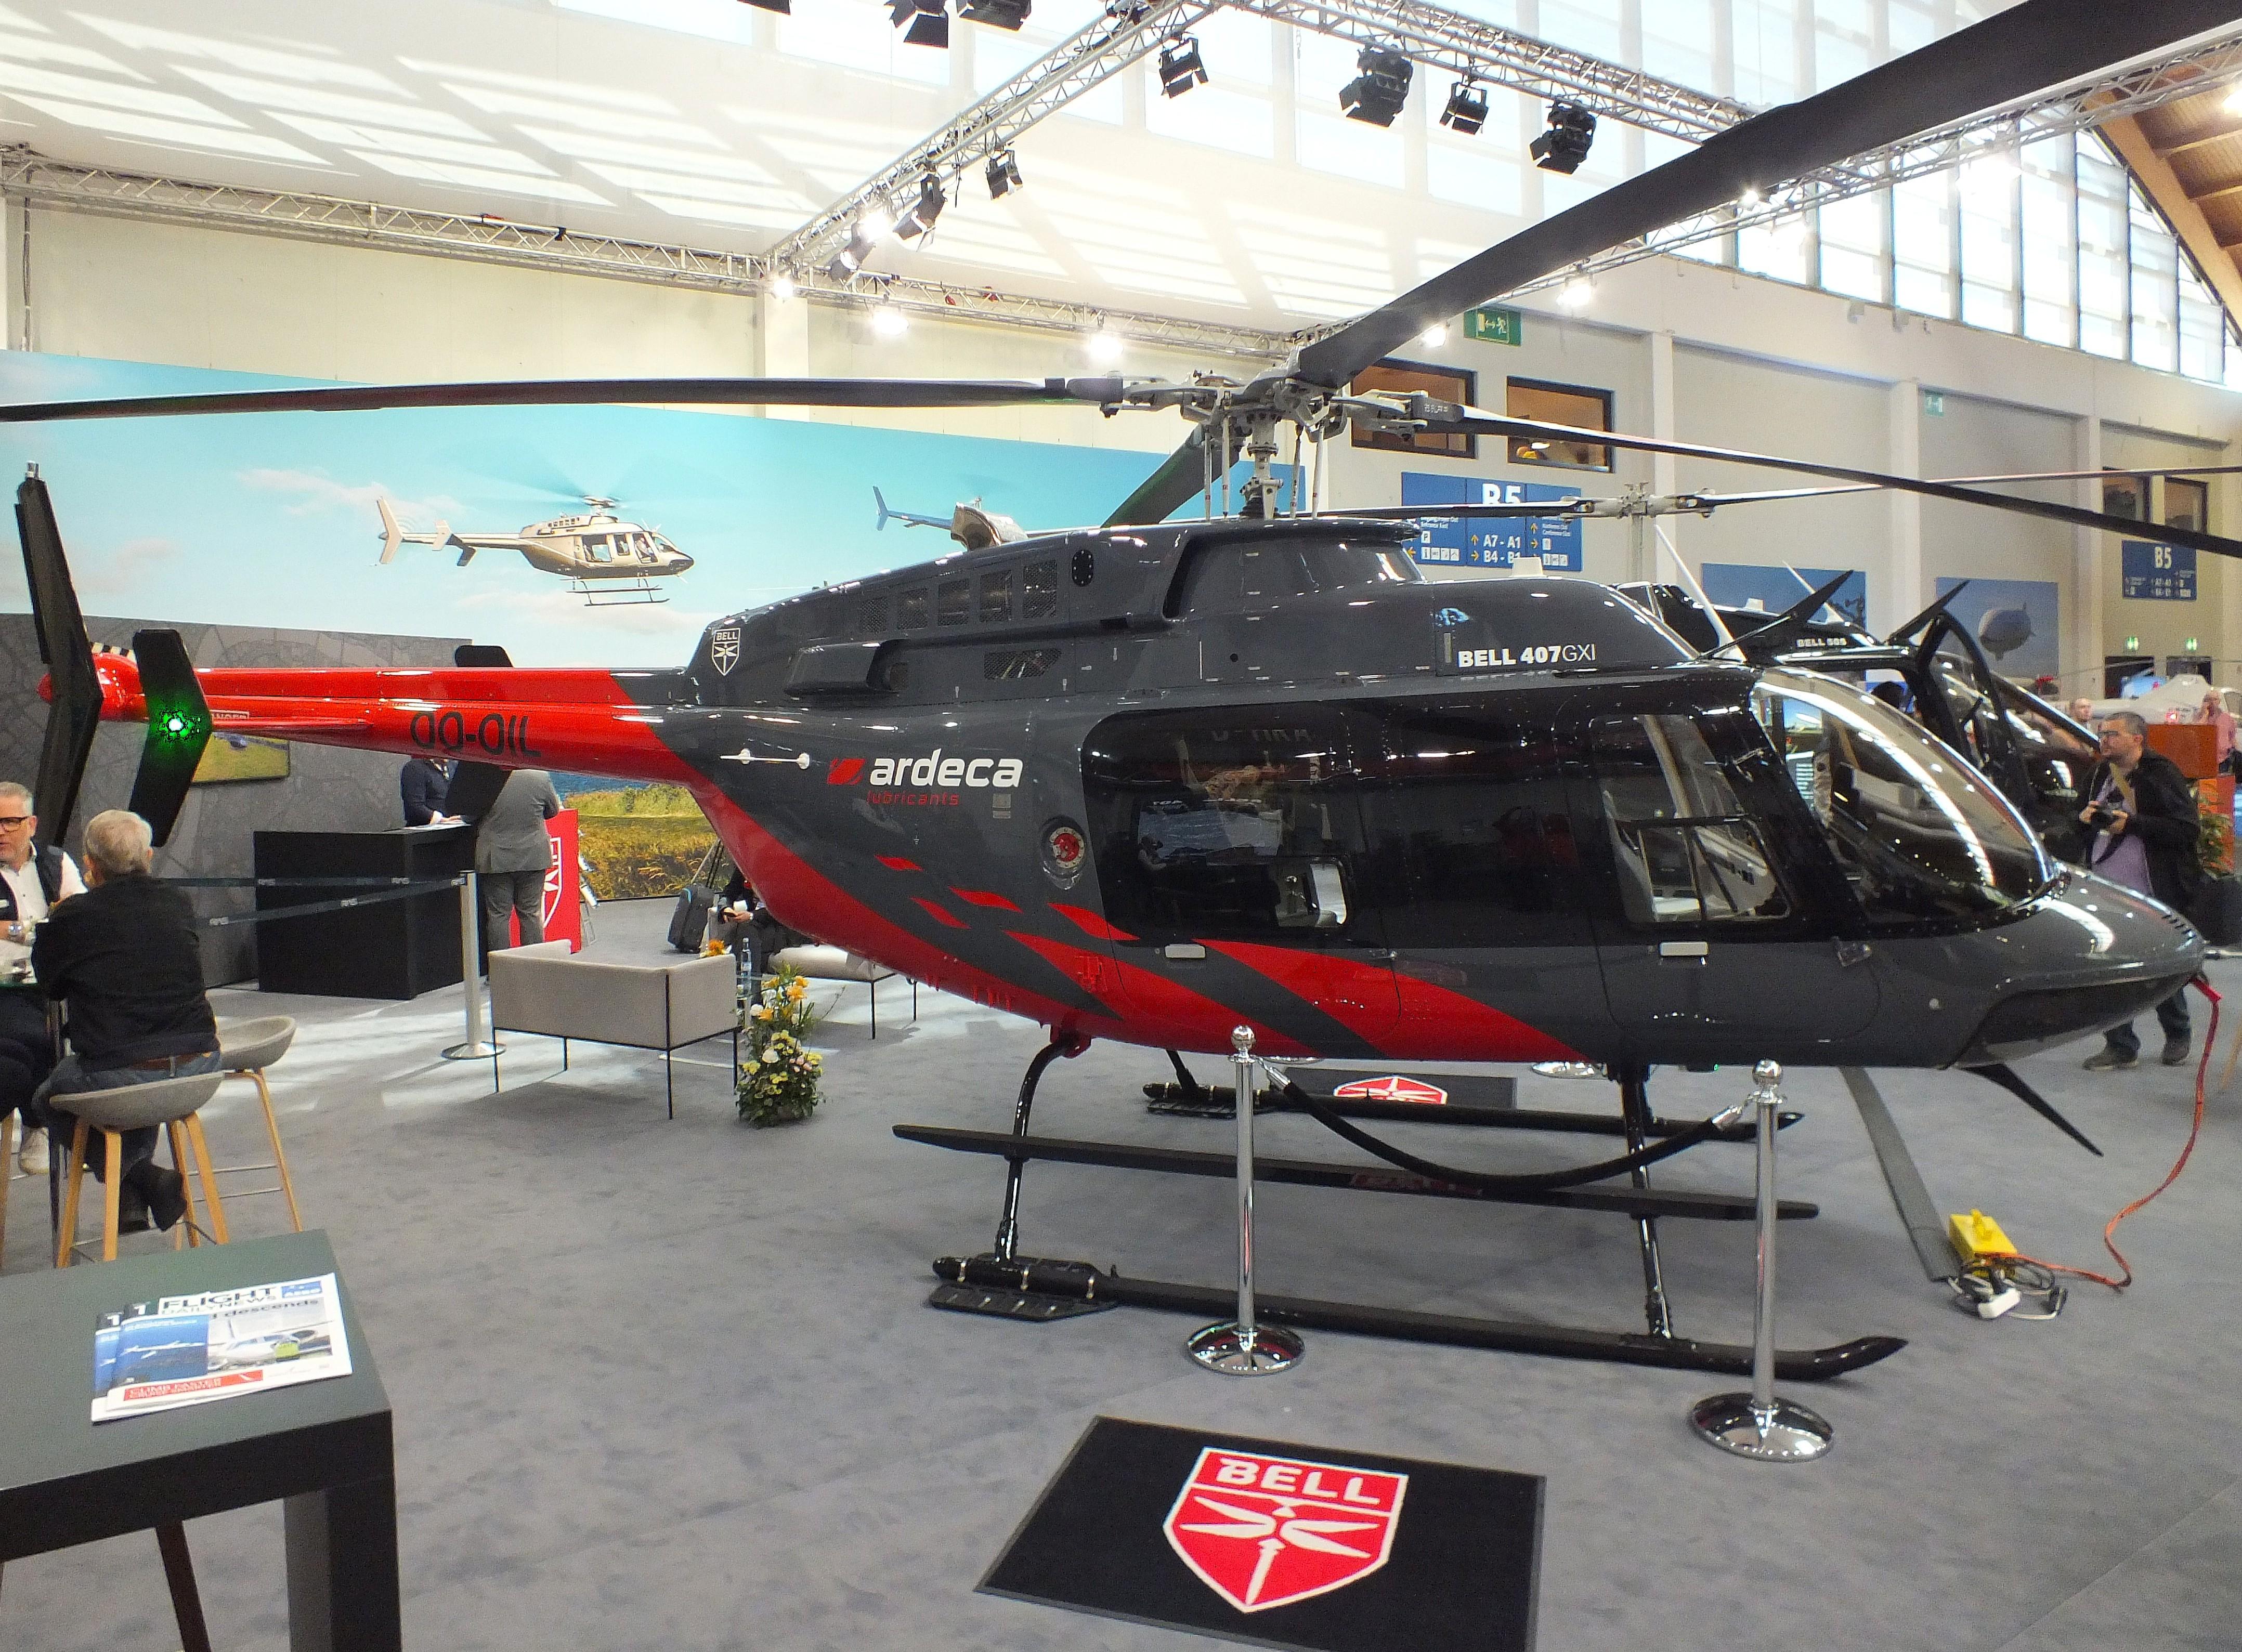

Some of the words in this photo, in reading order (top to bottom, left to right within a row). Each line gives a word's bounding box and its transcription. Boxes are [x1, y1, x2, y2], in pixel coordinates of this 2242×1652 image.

[1482, 483, 1521, 505] B5
[1483, 534, 1498, 547] A7
[1507, 536, 1521, 549] A1
[1483, 550, 1498, 563] B4
[2155, 546, 2172, 569] B5
[716, 631, 737, 640] BELL
[1796, 638, 1826, 647] BELL
[1458, 648, 1517, 667] BELL
[1520, 644, 1596, 664] 407GXI
[410, 711, 542, 757] OO-OIL
[869, 748, 1023, 788] ardeca
[867, 790, 960, 805] lubricants
[163, 1286, 277, 1309] FLIGHT
[1216, 1458, 1380, 1505] BELL
